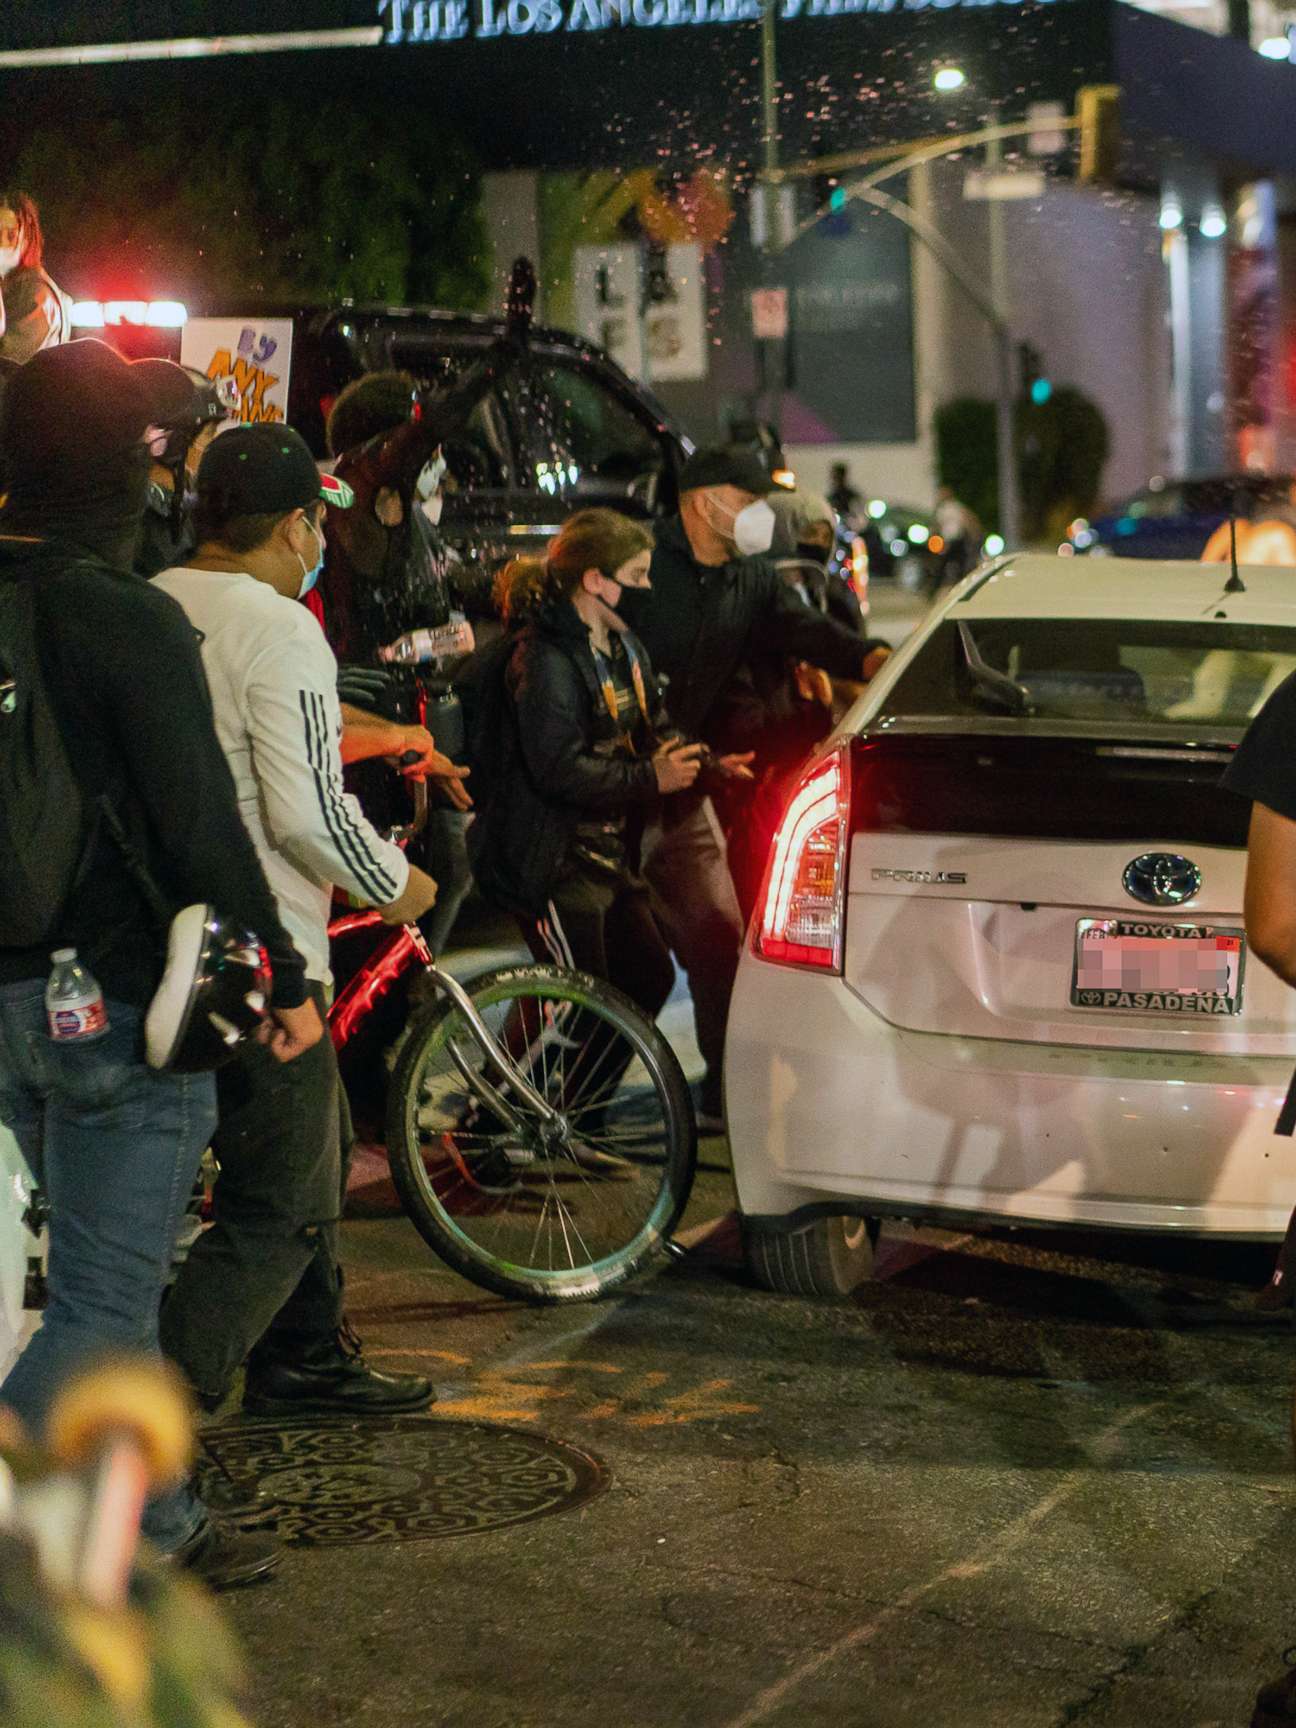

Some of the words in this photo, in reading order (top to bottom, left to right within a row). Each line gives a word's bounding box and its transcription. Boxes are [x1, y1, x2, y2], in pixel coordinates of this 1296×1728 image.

[237, 327, 277, 361] BY
[871, 868, 968, 884] PRIUS
[1121, 923, 1201, 939] TOYOTA
[1103, 991, 1230, 1014] PASADENA
